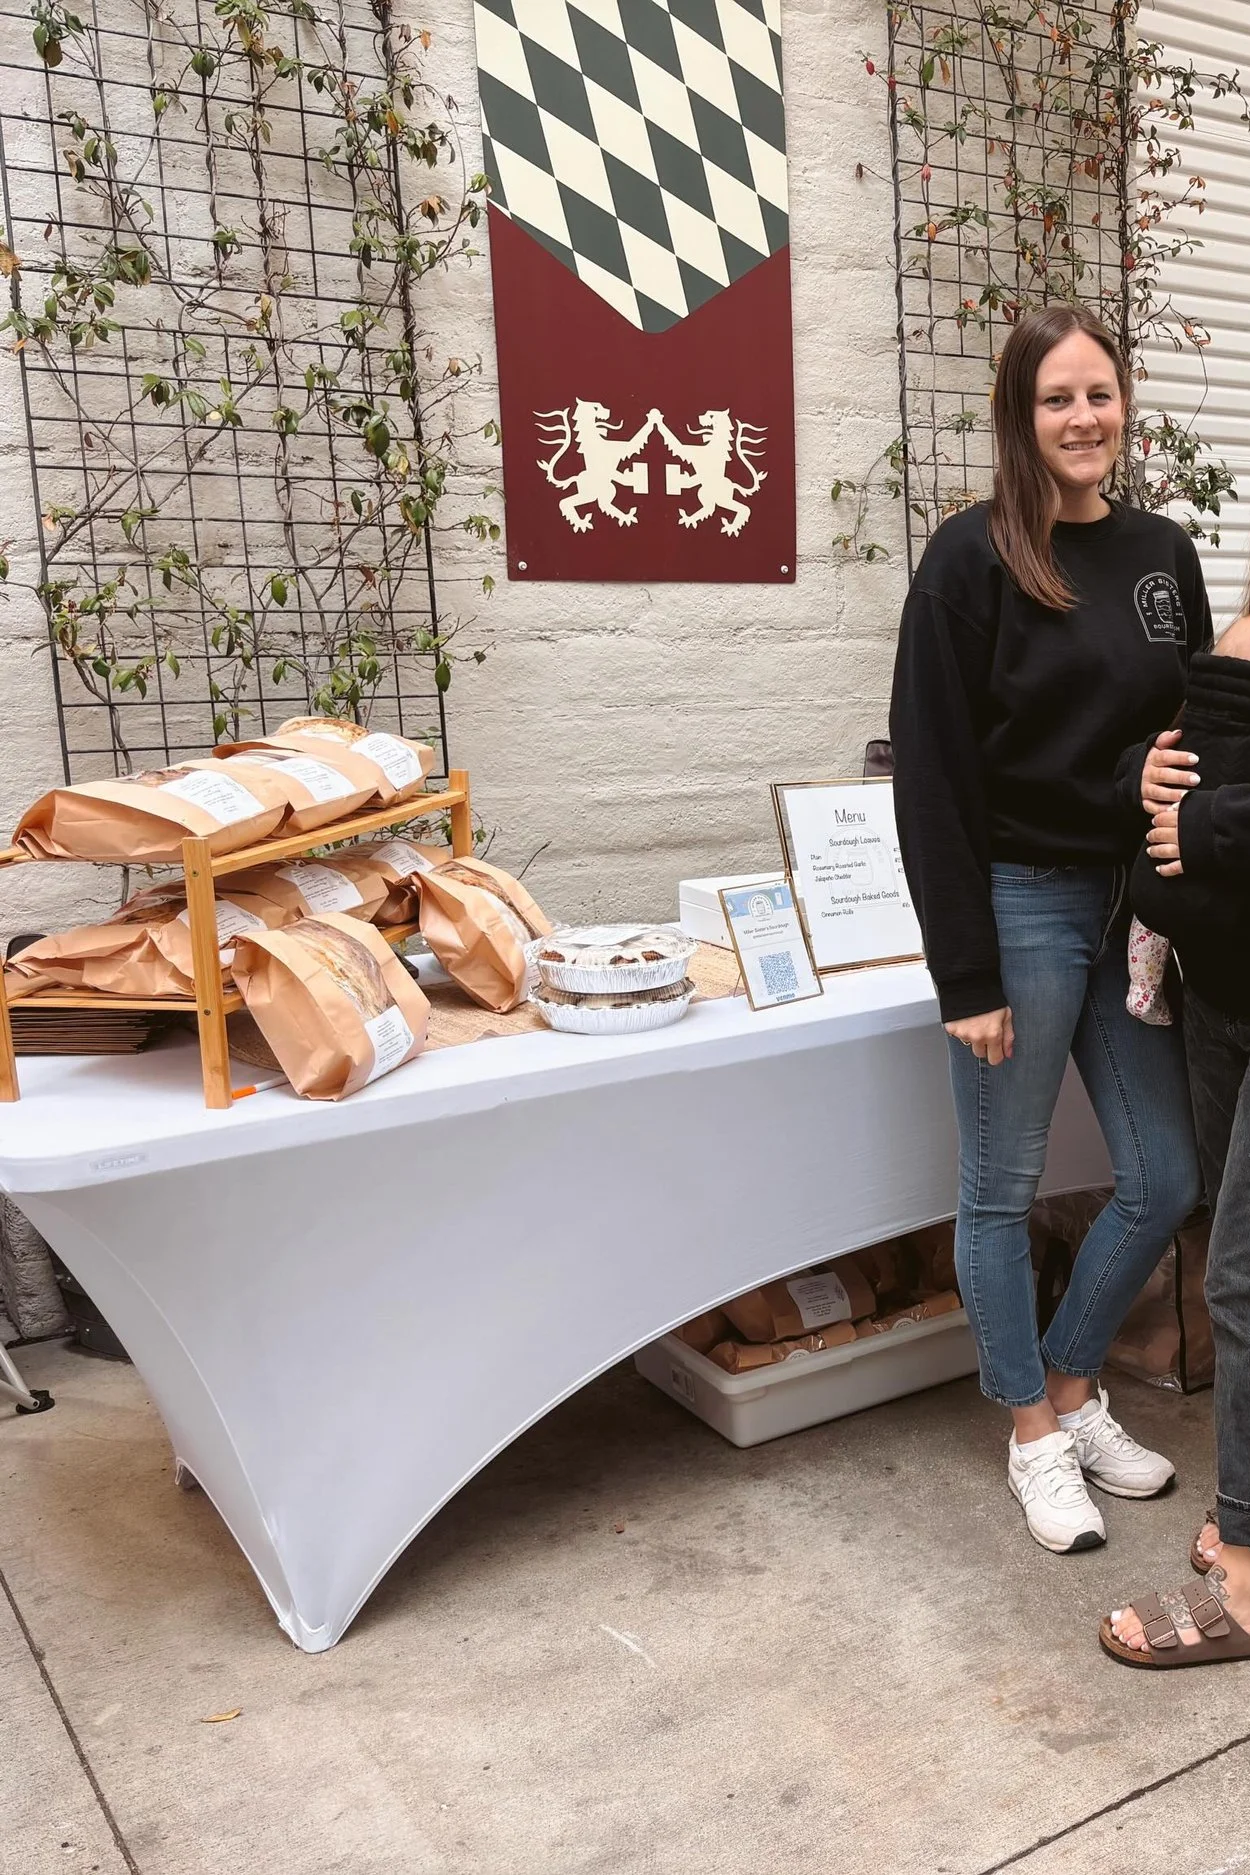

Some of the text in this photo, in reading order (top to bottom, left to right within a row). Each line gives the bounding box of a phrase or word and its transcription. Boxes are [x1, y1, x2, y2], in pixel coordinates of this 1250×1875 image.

[834, 808, 866, 824] Menu
[829, 836, 881, 847] Sourdough Loaves
[830, 890, 900, 904] Sourdough Baked Goods
